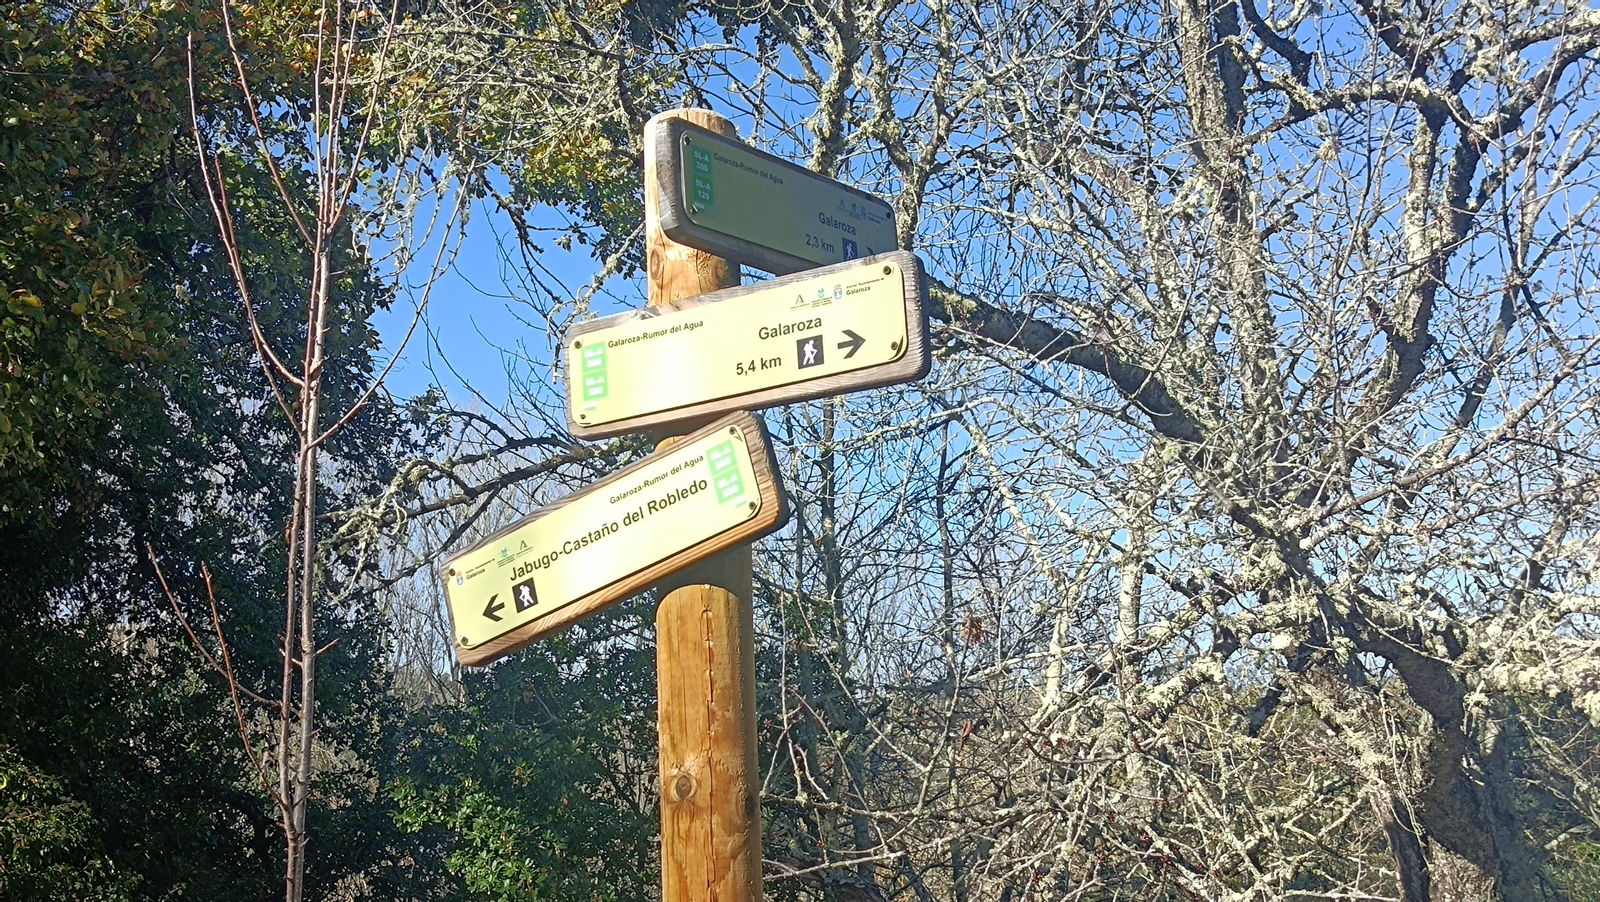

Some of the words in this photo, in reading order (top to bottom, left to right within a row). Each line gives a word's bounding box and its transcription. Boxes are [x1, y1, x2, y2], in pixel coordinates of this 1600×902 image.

[713, 152, 759, 175] Galaroza-Rumor
[759, 169, 769, 179] del
[769, 173, 784, 185] Agua
[818, 212, 857, 236] Galaroza
[805, 233, 819, 249] 2,3
[820, 238, 835, 254] km
[846, 286, 871, 296] Galaroza
[607, 328, 668, 348] Galaroza-Rumor
[669, 324, 682, 334] del
[683, 320, 704, 331] Agua
[758, 317, 822, 340] Galaroza
[736, 362, 756, 377] 5,4
[760, 356, 782, 371] km
[609, 471, 669, 505] Galaroza-Rumor
[670, 464, 683, 475] del
[683, 454, 704, 469] Agua
[509, 521, 619, 581] Jabugo-Castaño
[622, 506, 644, 527] del
[646, 479, 708, 515] Robledo
